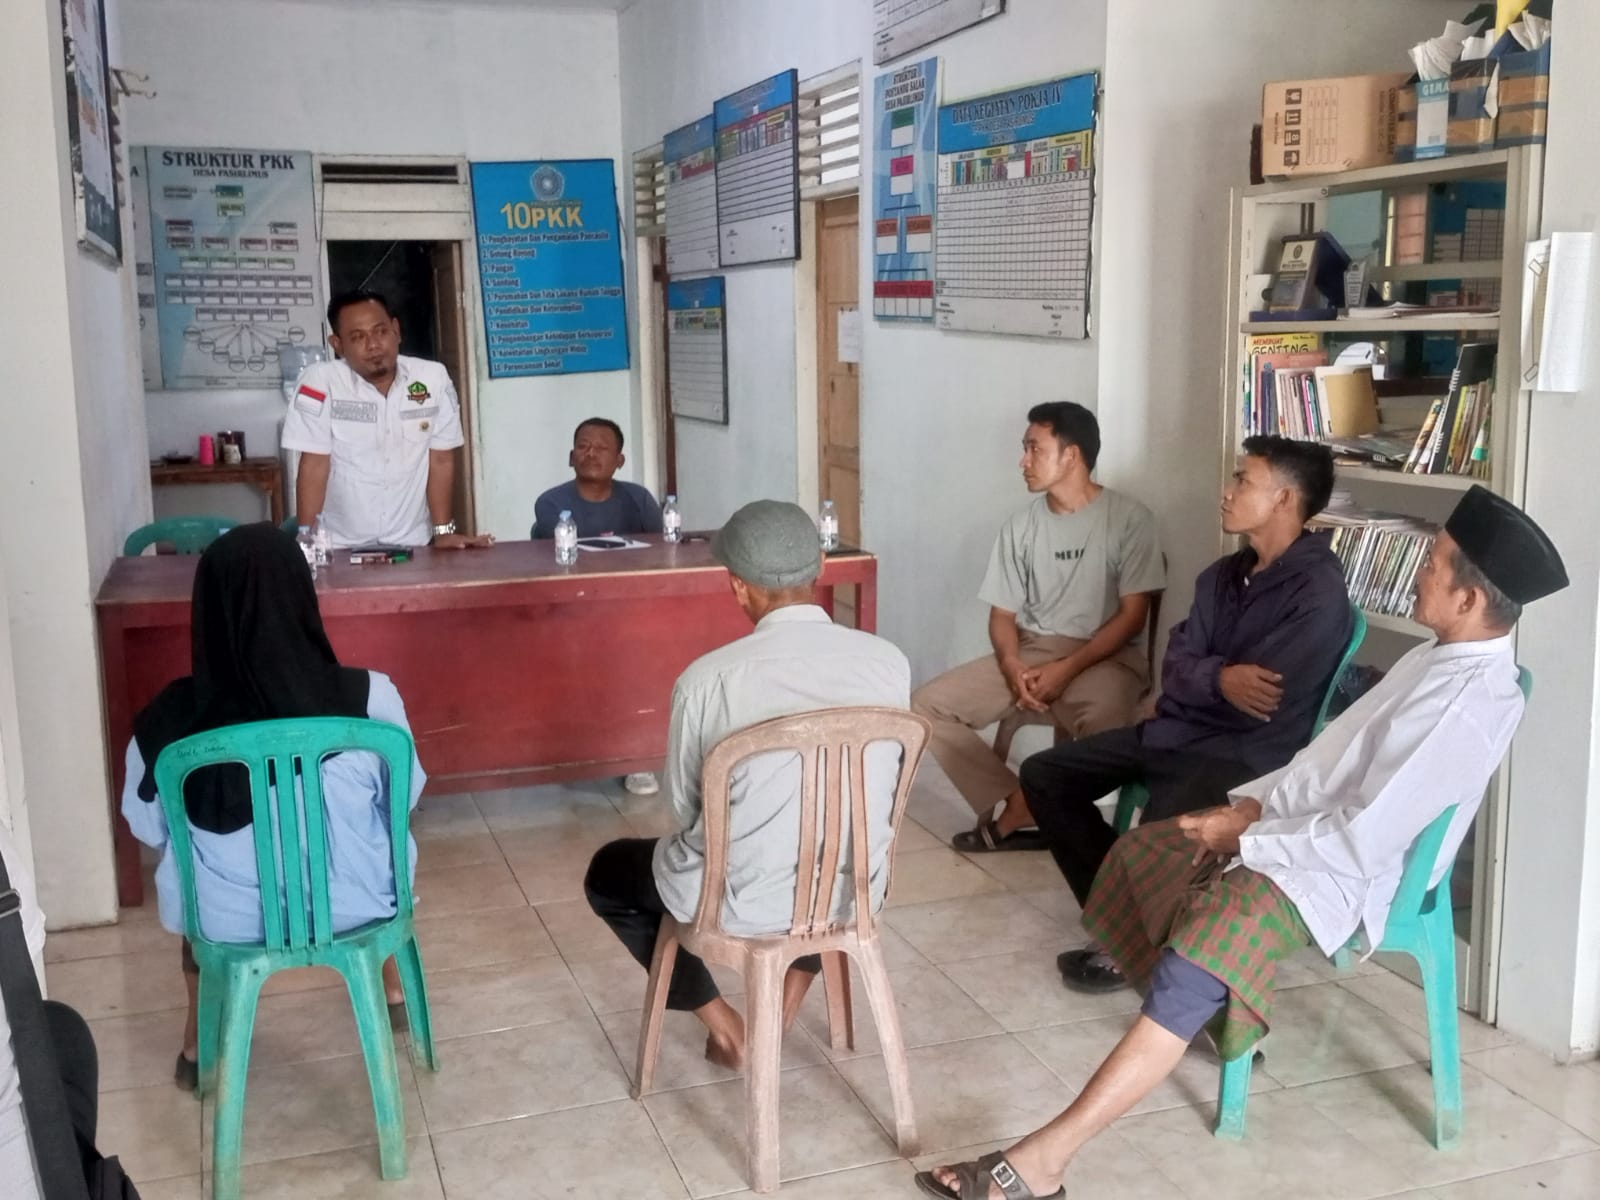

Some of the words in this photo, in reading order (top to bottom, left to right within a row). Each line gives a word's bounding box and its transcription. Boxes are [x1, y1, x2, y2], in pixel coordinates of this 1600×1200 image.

[1018, 90, 1048, 113] POKJA
[162, 151, 255, 168] STRUKTUR
[260, 154, 295, 170] PKK
[193, 169, 216, 177] DESA
[218, 169, 269, 178] PASIRLIMUS
